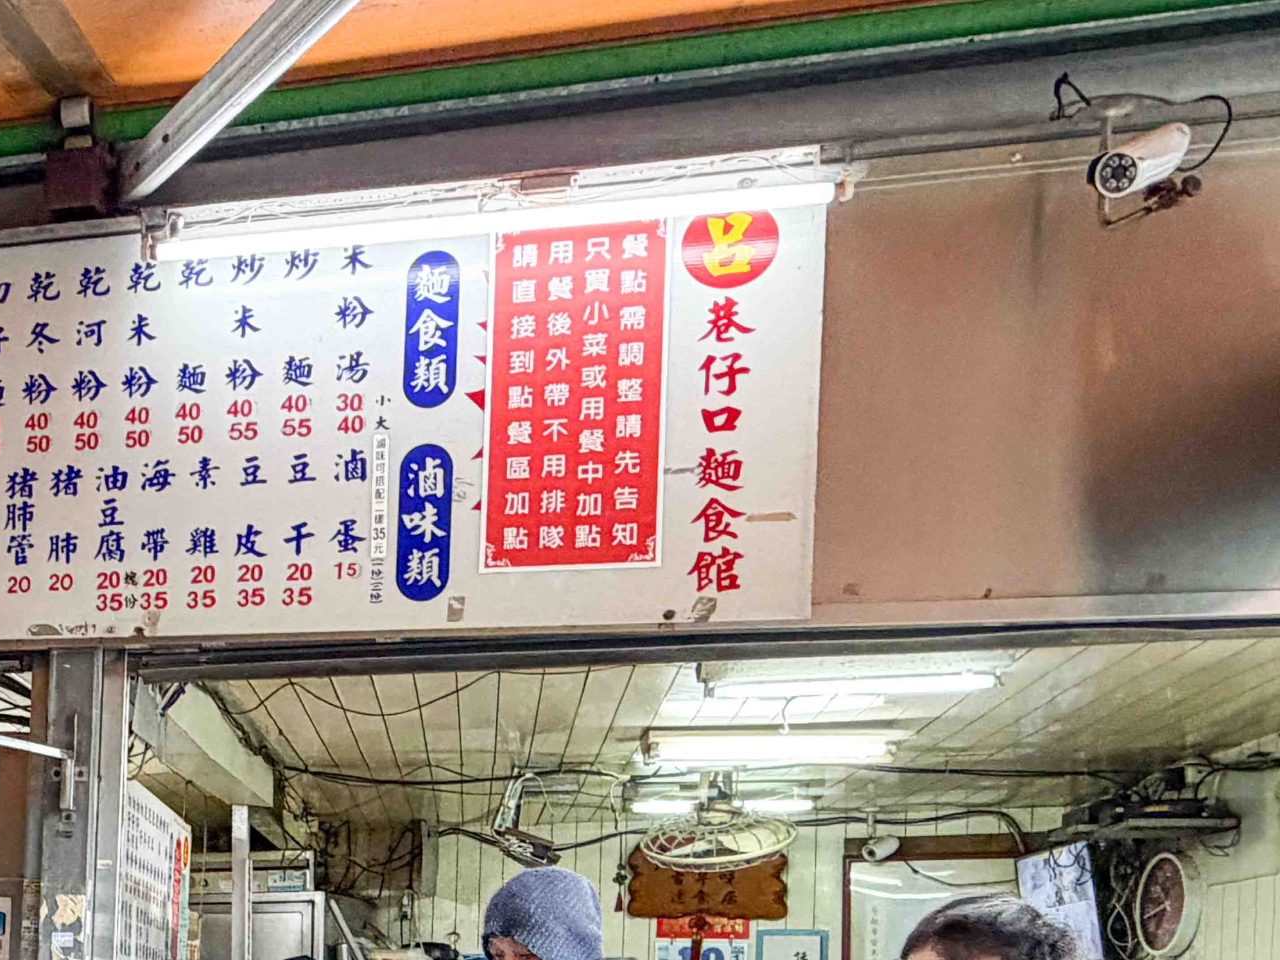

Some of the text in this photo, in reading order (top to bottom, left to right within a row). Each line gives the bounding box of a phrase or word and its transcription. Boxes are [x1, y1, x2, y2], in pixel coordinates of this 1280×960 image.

[702, 212, 757, 277] 呂
[225, 254, 265, 391] 炒米粉
[282, 249, 320, 387] 炒麵
[334, 245, 375, 383] 米粉湯
[71, 266, 111, 402] 乾河粉
[121, 262, 161, 398] 乾米粉
[176, 258, 213, 394] 乾麵
[409, 264, 455, 394] 麵食類
[22, 271, 60, 405] 乾冬粉
[502, 244, 539, 551] 請直接到點餐區加點
[539, 240, 575, 549] 用餐後外帶不用排隊
[575, 237, 611, 549] 只買小菜或用餐中加點
[612, 233, 649, 547] 餐點需調整請先告知
[227, 399, 252, 417] 40
[281, 394, 307, 412] 40
[336, 393, 363, 412] 30
[376, 395, 391, 406] 小
[25, 413, 49, 430] 40
[74, 412, 98, 429] 40
[125, 406, 150, 425] 40
[175, 403, 201, 421] 40
[229, 422, 258, 440] 55
[281, 418, 312, 437] 55
[337, 415, 364, 434] 40
[374, 416, 390, 430] 大
[26, 435, 50, 453] 50
[74, 432, 99, 450] 50
[125, 429, 150, 448] 50
[177, 425, 203, 444] 50
[687, 296, 756, 593] 巷仔口麵食館
[140, 459, 176, 561] 海帶
[185, 456, 220, 558] 素雞
[234, 456, 268, 558] 豆皮
[283, 453, 316, 556] 豆干
[329, 449, 367, 554] 滷蛋
[94, 465, 128, 563] 油豆腐
[401, 457, 447, 588] 滷味類
[97, 571, 120, 590] 20
[143, 568, 167, 587] 20
[190, 565, 216, 584] 20
[237, 564, 263, 582] 20
[286, 563, 312, 581] 20
[334, 563, 357, 580] 15
[7, 576, 31, 594] 20
[49, 574, 73, 591] 20
[96, 593, 123, 611] 35
[140, 591, 168, 610] 35
[186, 589, 216, 609] 35
[237, 588, 265, 607] 35
[282, 587, 312, 606] 35
